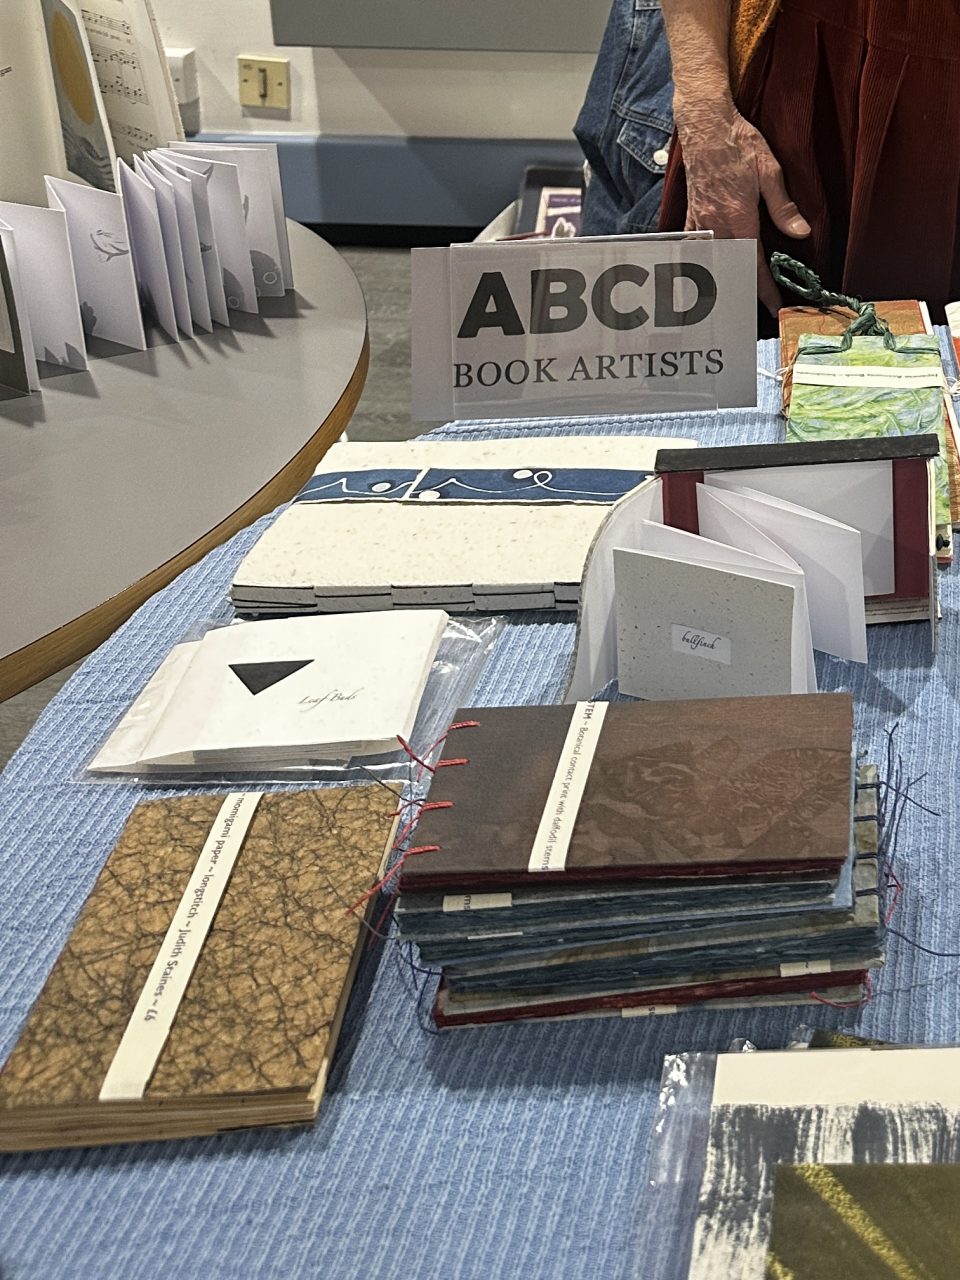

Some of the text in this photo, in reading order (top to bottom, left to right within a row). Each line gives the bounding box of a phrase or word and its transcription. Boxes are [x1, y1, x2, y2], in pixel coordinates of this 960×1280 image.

[457, 262, 717, 338] ABCD
[453, 349, 724, 388] BOOK ARTISTS
[574, 726, 589, 756] Botanical
[566, 756, 580, 782] contact
[560, 782, 571, 800] print
[223, 796, 245, 838] momigami
[554, 799, 566, 816] with
[548, 816, 562, 842] daffodil
[210, 836, 226, 865] paper
[541, 845, 554, 870] stems
[190, 874, 214, 919] longstitch
[173, 929, 192, 960] Judith
[153, 960, 178, 998] Staines
